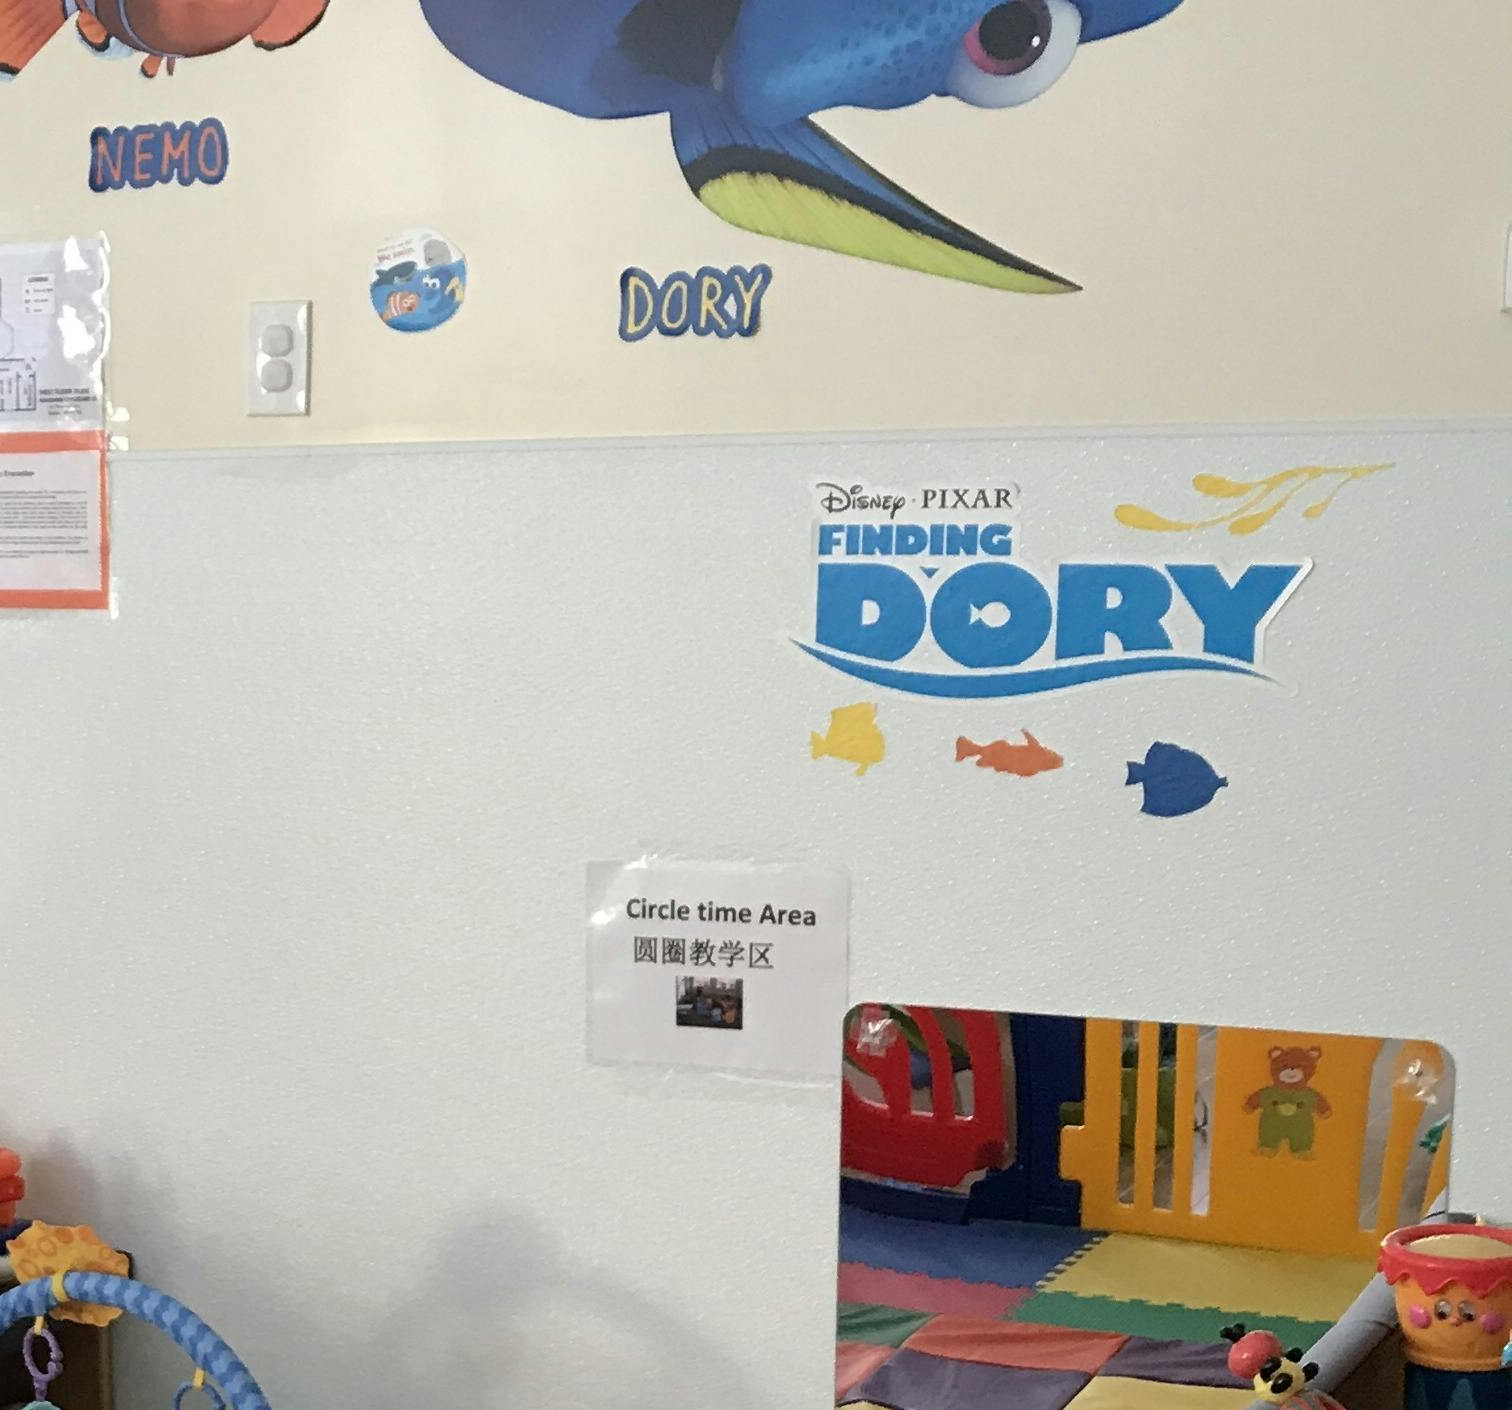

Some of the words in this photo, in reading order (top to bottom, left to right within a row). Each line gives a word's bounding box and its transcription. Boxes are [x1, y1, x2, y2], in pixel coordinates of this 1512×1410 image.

[91, 121, 226, 188] NEMO
[622, 267, 768, 338] DORY
[921, 488, 1013, 509] PIXAR
[818, 523, 1013, 555] FINDING
[816, 562, 1301, 668] DORY
[626, 897, 690, 921] Circle
[697, 900, 752, 924] time
[759, 903, 817, 926] Area
[633, 936, 774, 968] 圆圈教学区
